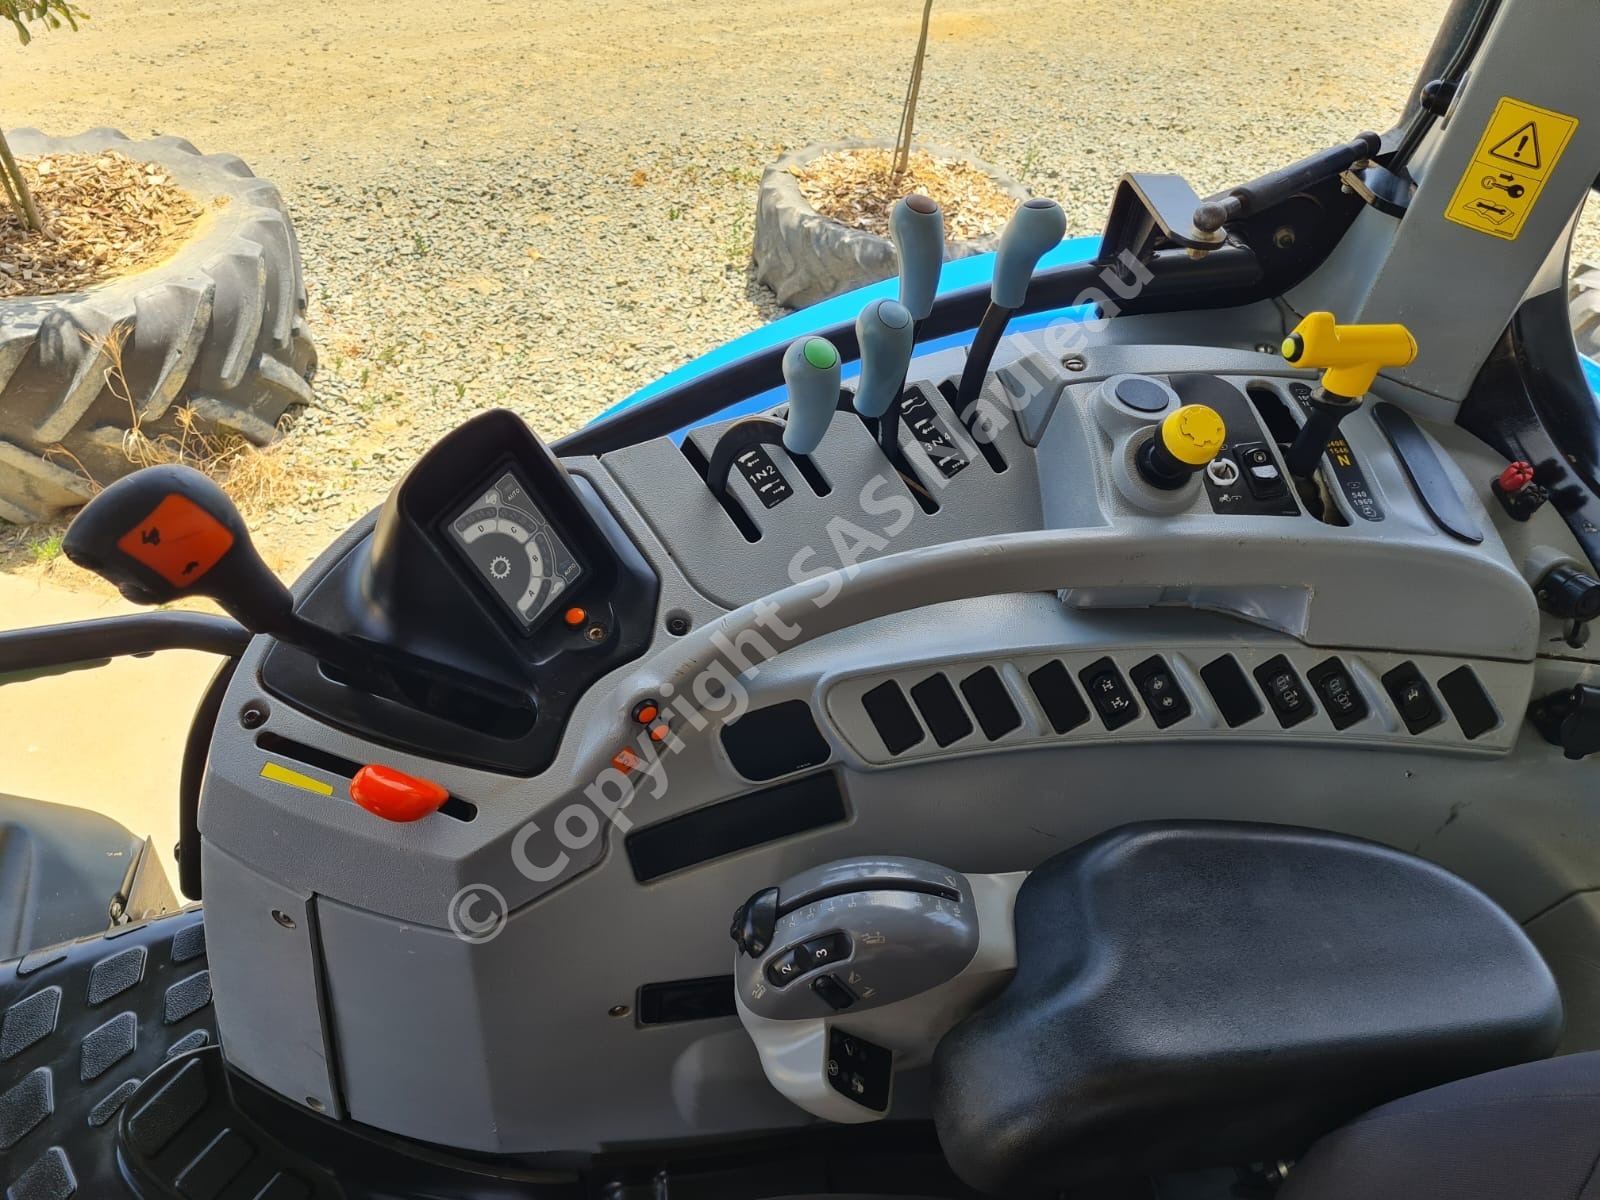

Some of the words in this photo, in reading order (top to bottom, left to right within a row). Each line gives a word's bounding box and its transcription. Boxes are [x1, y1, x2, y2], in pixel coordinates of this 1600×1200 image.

[1337, 454, 1352, 467] N
[508, 488, 520, 501] AUTO
[564, 562, 576, 576] AUTO
[815, 948, 828, 958] 3
[781, 963, 792, 975] 2
